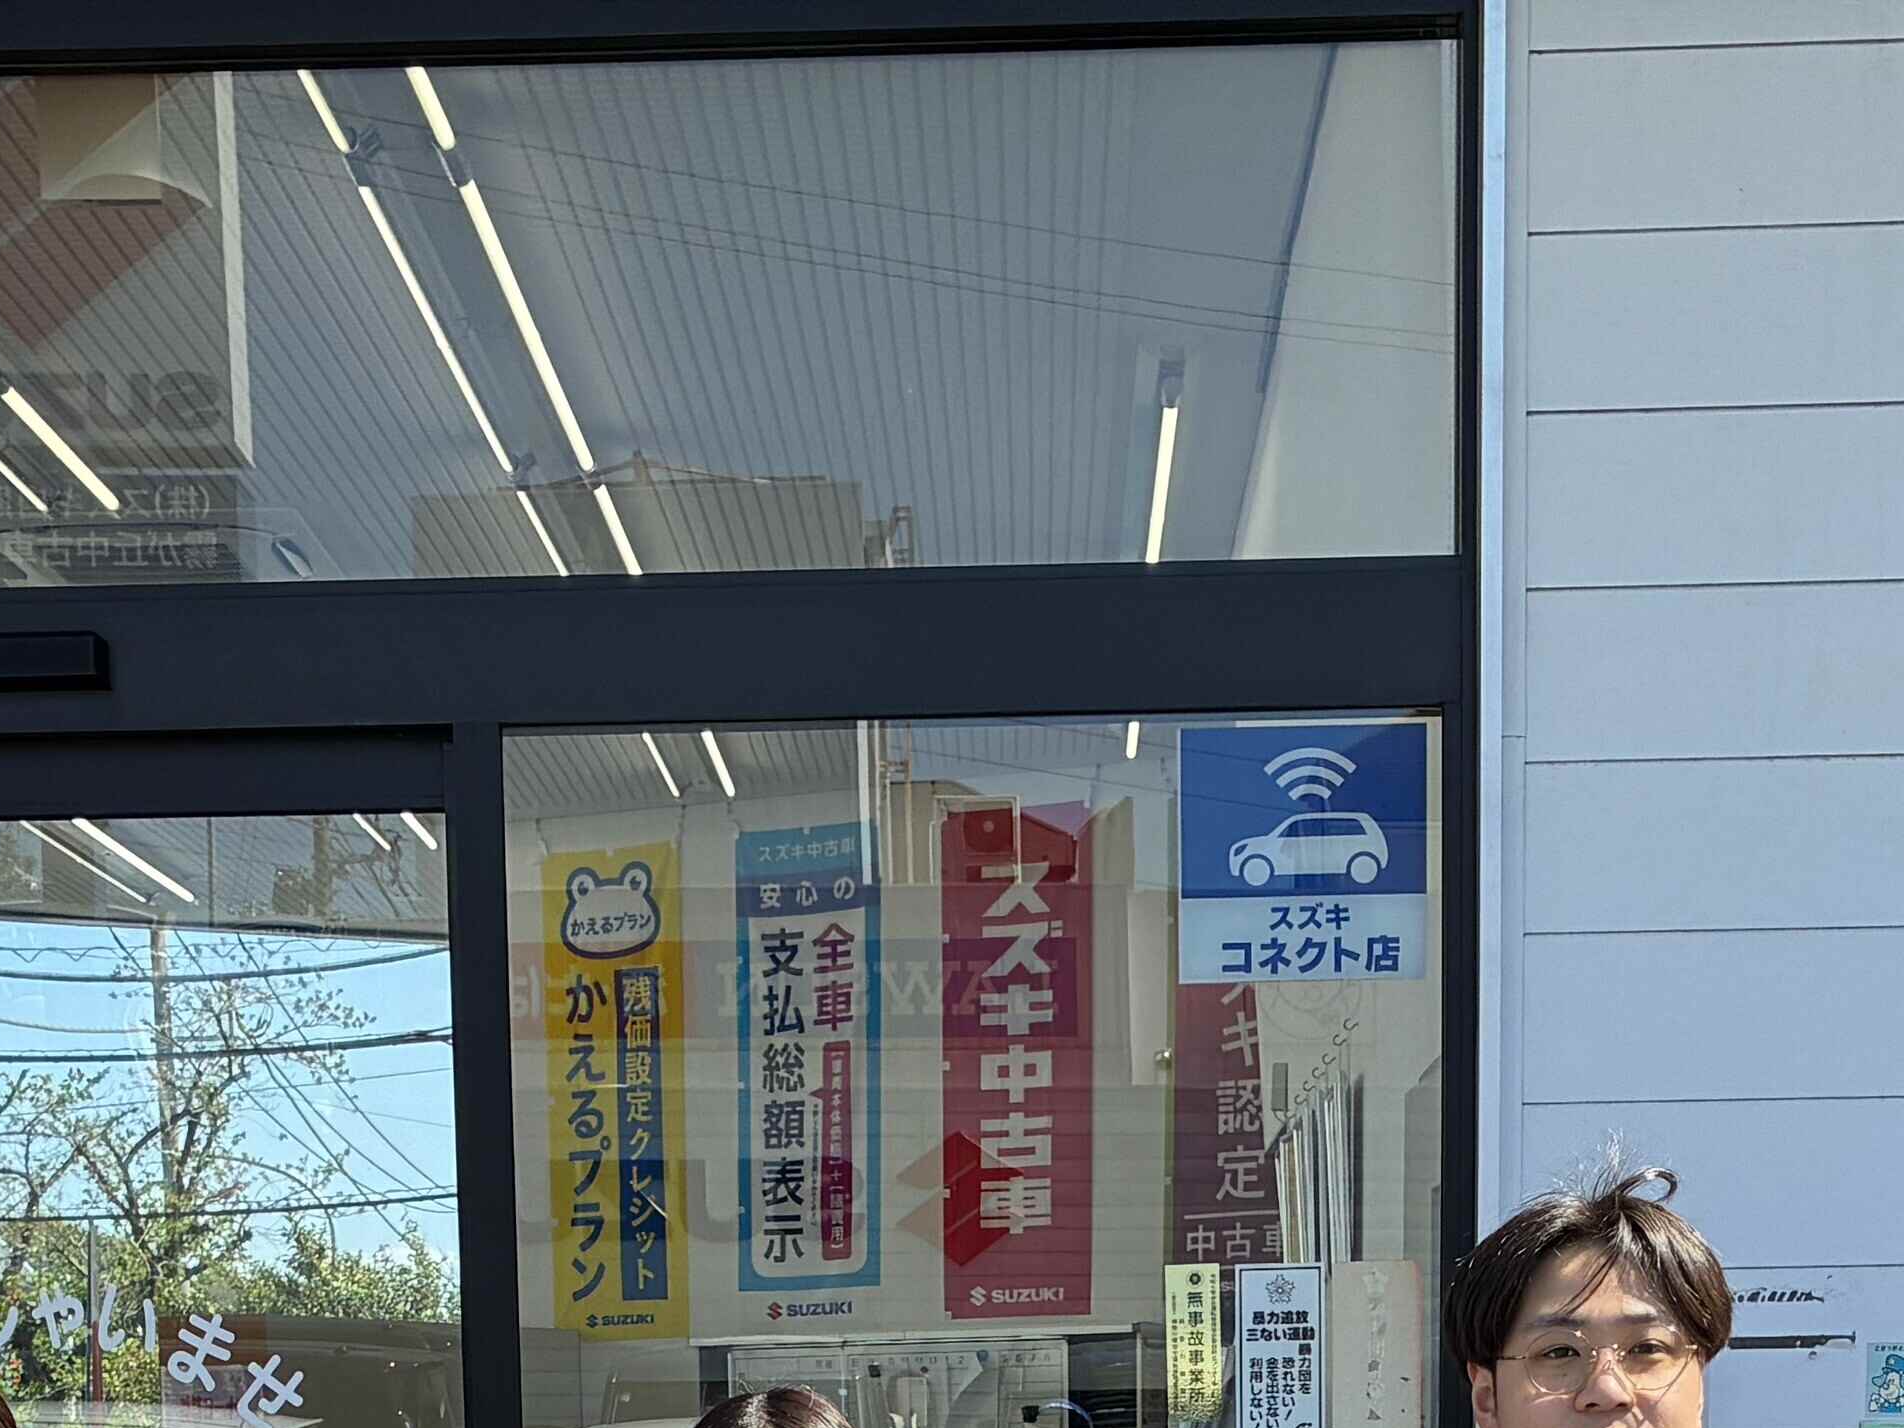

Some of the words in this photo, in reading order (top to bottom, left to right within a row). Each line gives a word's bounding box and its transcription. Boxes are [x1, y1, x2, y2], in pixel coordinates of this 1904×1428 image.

[760, 839, 856, 862] スズキ中古車
[760, 876, 856, 910] 安心の
[570, 910, 652, 937] かえるプラン
[1269, 902, 1350, 930] スズキ
[1222, 935, 1400, 975] コネクト店
[812, 922, 856, 1033] 全車
[980, 862, 1063, 1234] スズキ中古車
[760, 927, 806, 1265] 支払総額表示
[1216, 983, 1265, 1201] キ認定
[566, 973, 611, 1302] かえるプラン
[624, 975, 656, 1291] 残価設定クレジット
[786, 1300, 854, 1317] SUZUKI
[991, 1287, 1064, 1304] SUZUKI
[600, 1313, 654, 1328] SUZUKI
[1246, 1328, 1315, 1342] 三ない運動
[1252, 1311, 1309, 1325] 暴力追放
[1187, 1291, 1204, 1404] 無事故事業所
[1298, 1343, 1312, 1395] 暴力団を
